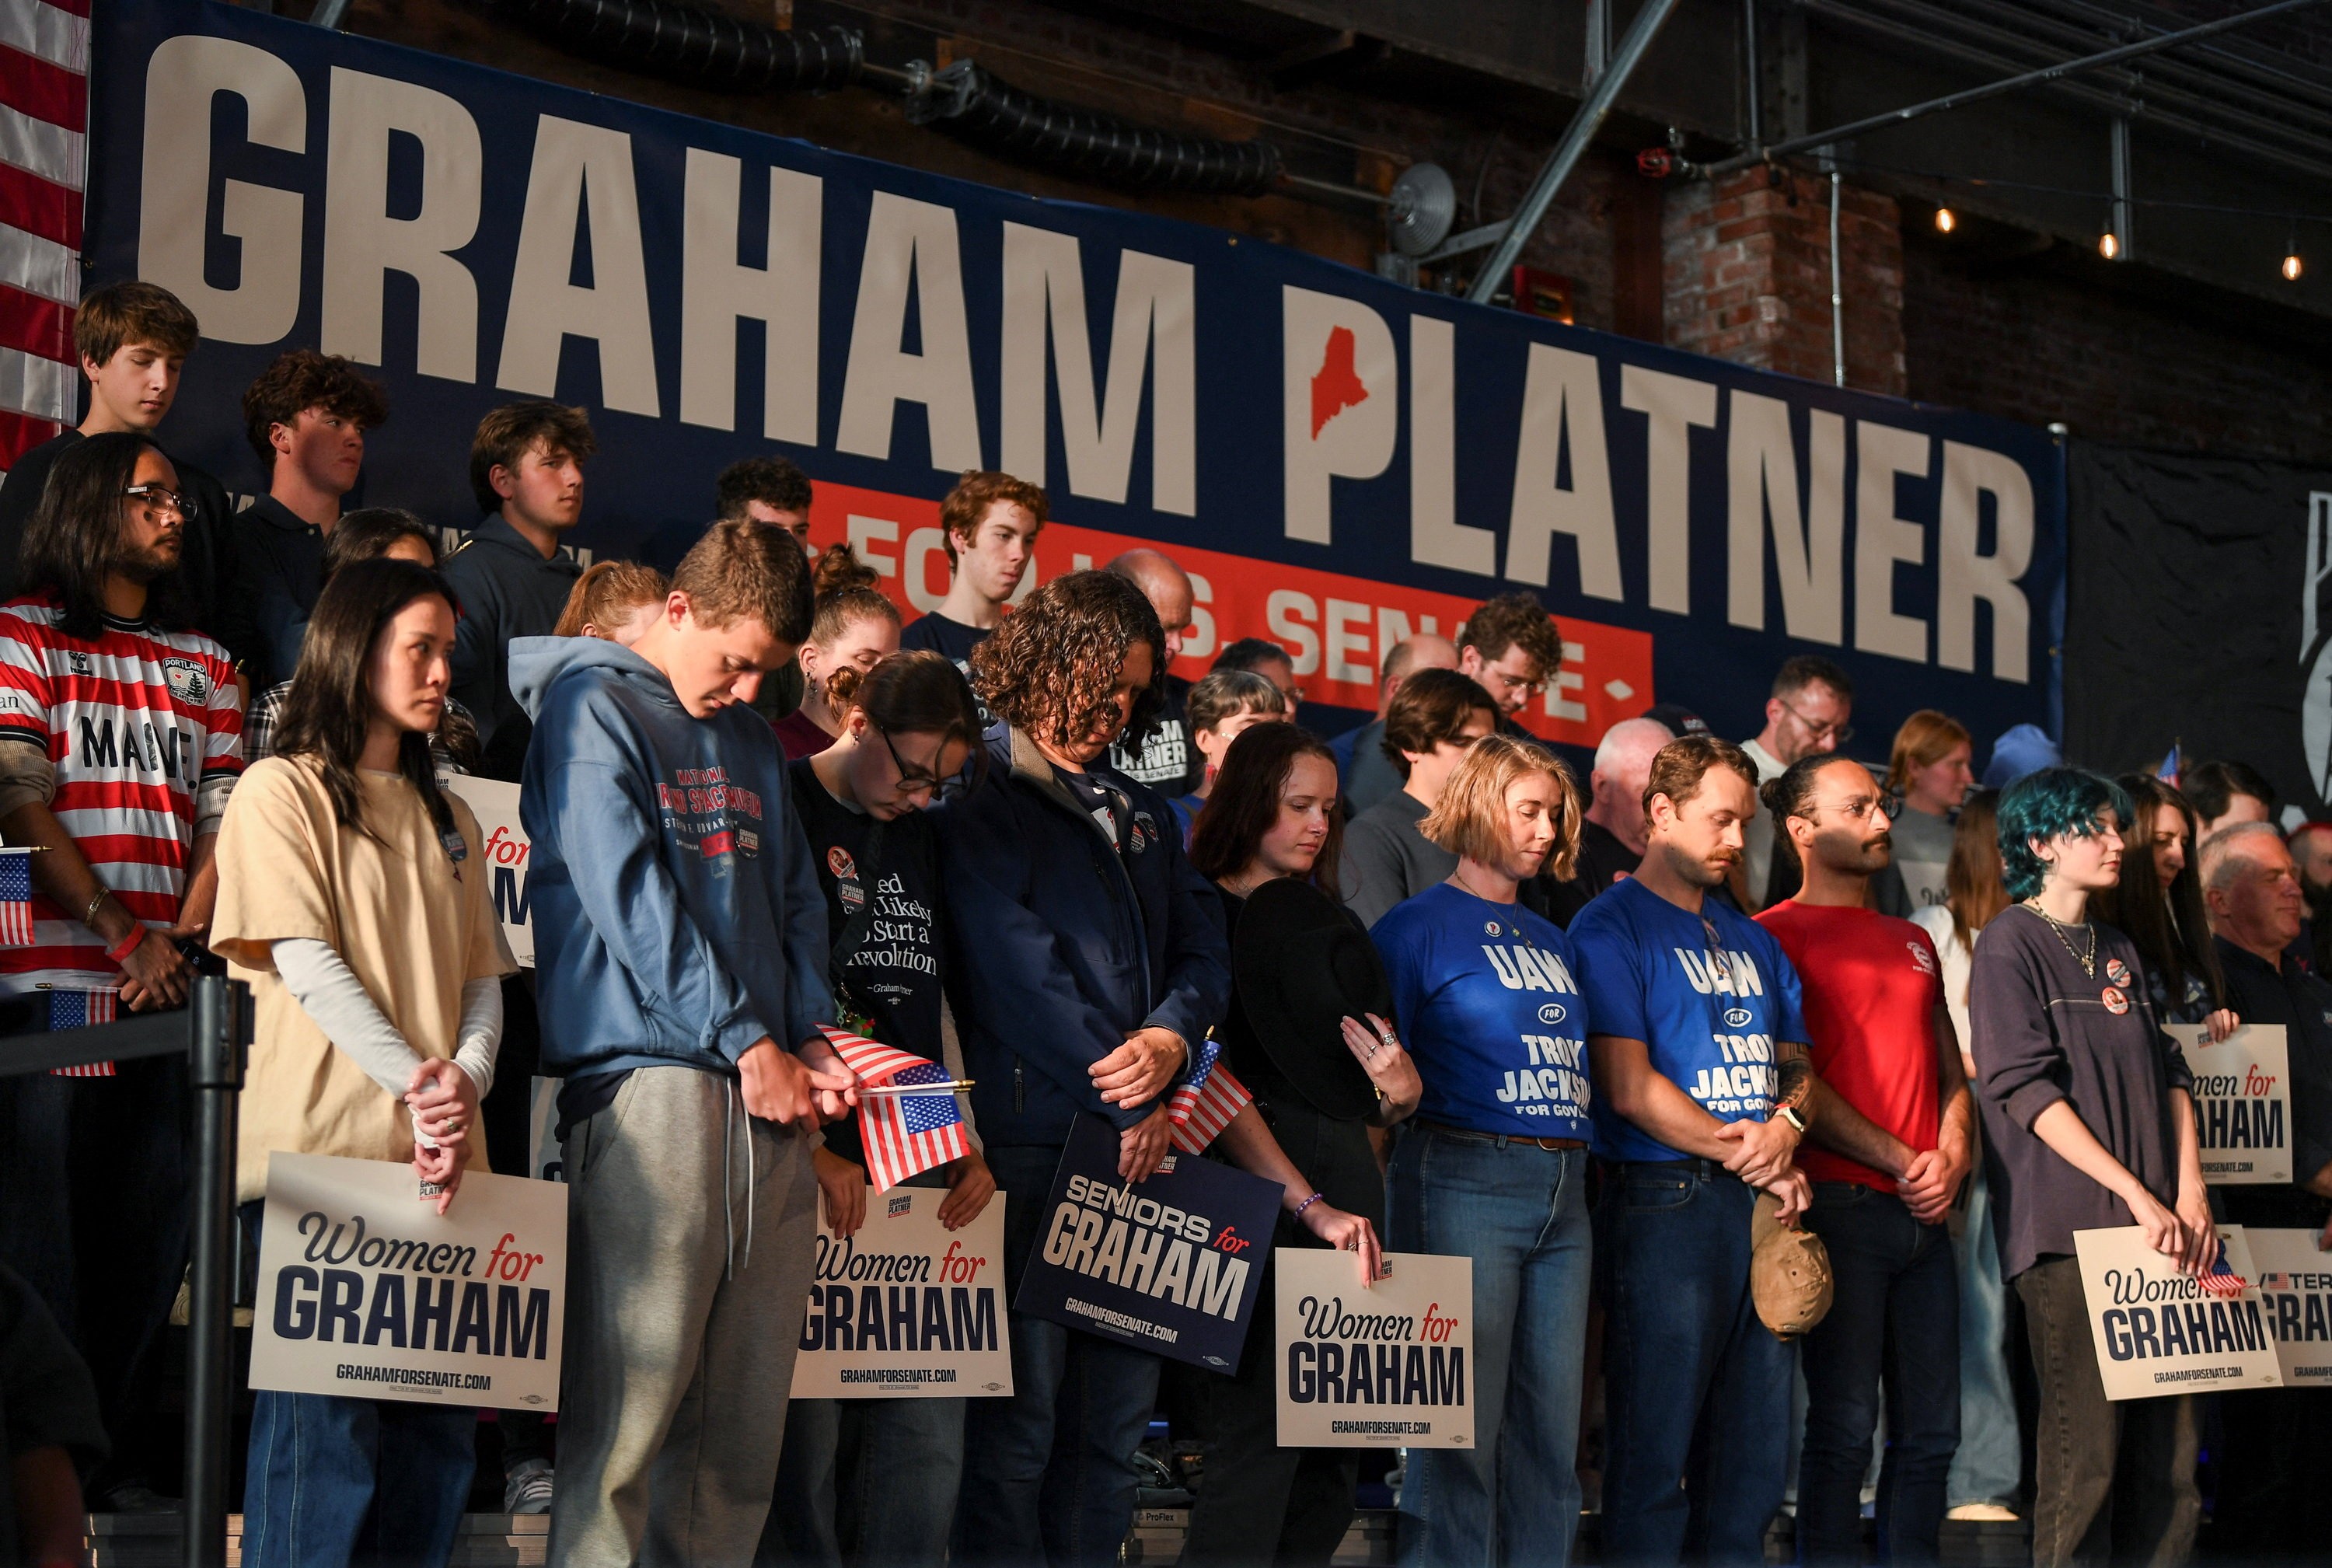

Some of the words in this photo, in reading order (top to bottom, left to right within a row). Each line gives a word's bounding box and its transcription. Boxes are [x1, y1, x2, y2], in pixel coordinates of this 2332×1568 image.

[138, 35, 1196, 517] GRAHAM
[1283, 285, 2035, 684] PLATNER
[165, 659, 205, 673] PORTLAND
[1266, 589, 1587, 723] SENE
[484, 826, 531, 865] for
[842, 884, 864, 895] GRAHAM
[842, 890, 864, 901] PLATNER
[874, 920, 915, 942] Start
[919, 927, 930, 944] a
[1481, 945, 1578, 995] UAW
[1545, 1008, 1559, 1018] FOR
[1730, 1012, 1745, 1023] FOR
[1520, 1035, 1583, 1070] TROY
[1713, 1034, 1775, 1063] TROY
[2194, 1075, 2237, 1096] men
[2244, 1063, 2276, 1096] for
[1514, 1104, 1550, 1116] FOR
[1707, 1099, 1741, 1112] FOR
[888, 1195, 911, 1207] GRAHAM
[888, 1203, 910, 1214] PLATNER
[1067, 1175, 1211, 1243] SENIORS
[1213, 1226, 1249, 1254] for
[298, 1211, 476, 1276] Women
[485, 1233, 543, 1281] for
[815, 1234, 930, 1283] Women
[939, 1240, 986, 1283] for
[1042, 1202, 1250, 1322] GRAHAM
[2104, 1267, 2211, 1305] Women
[273, 1264, 550, 1360] GRAHAM
[798, 1284, 998, 1351] GRAHAM
[1065, 1297, 1178, 1343] GRAHAMFORSENATE.COM
[1298, 1296, 1413, 1341] Women
[1419, 1302, 1458, 1343] for
[2102, 1300, 2267, 1361] GRAHAM
[337, 1364, 491, 1390] GRAHAMFORSENATE.COM
[840, 1369, 956, 1383] GRAHAMFORSENATE.COM
[1288, 1341, 1464, 1406] GRAHAM
[2154, 1367, 2243, 1384] GRAHAMFORSENATE.COM
[1332, 1420, 1431, 1434] GRAHAMFORSENATE.COM
[1146, 1513, 1174, 1521] ProFlex
